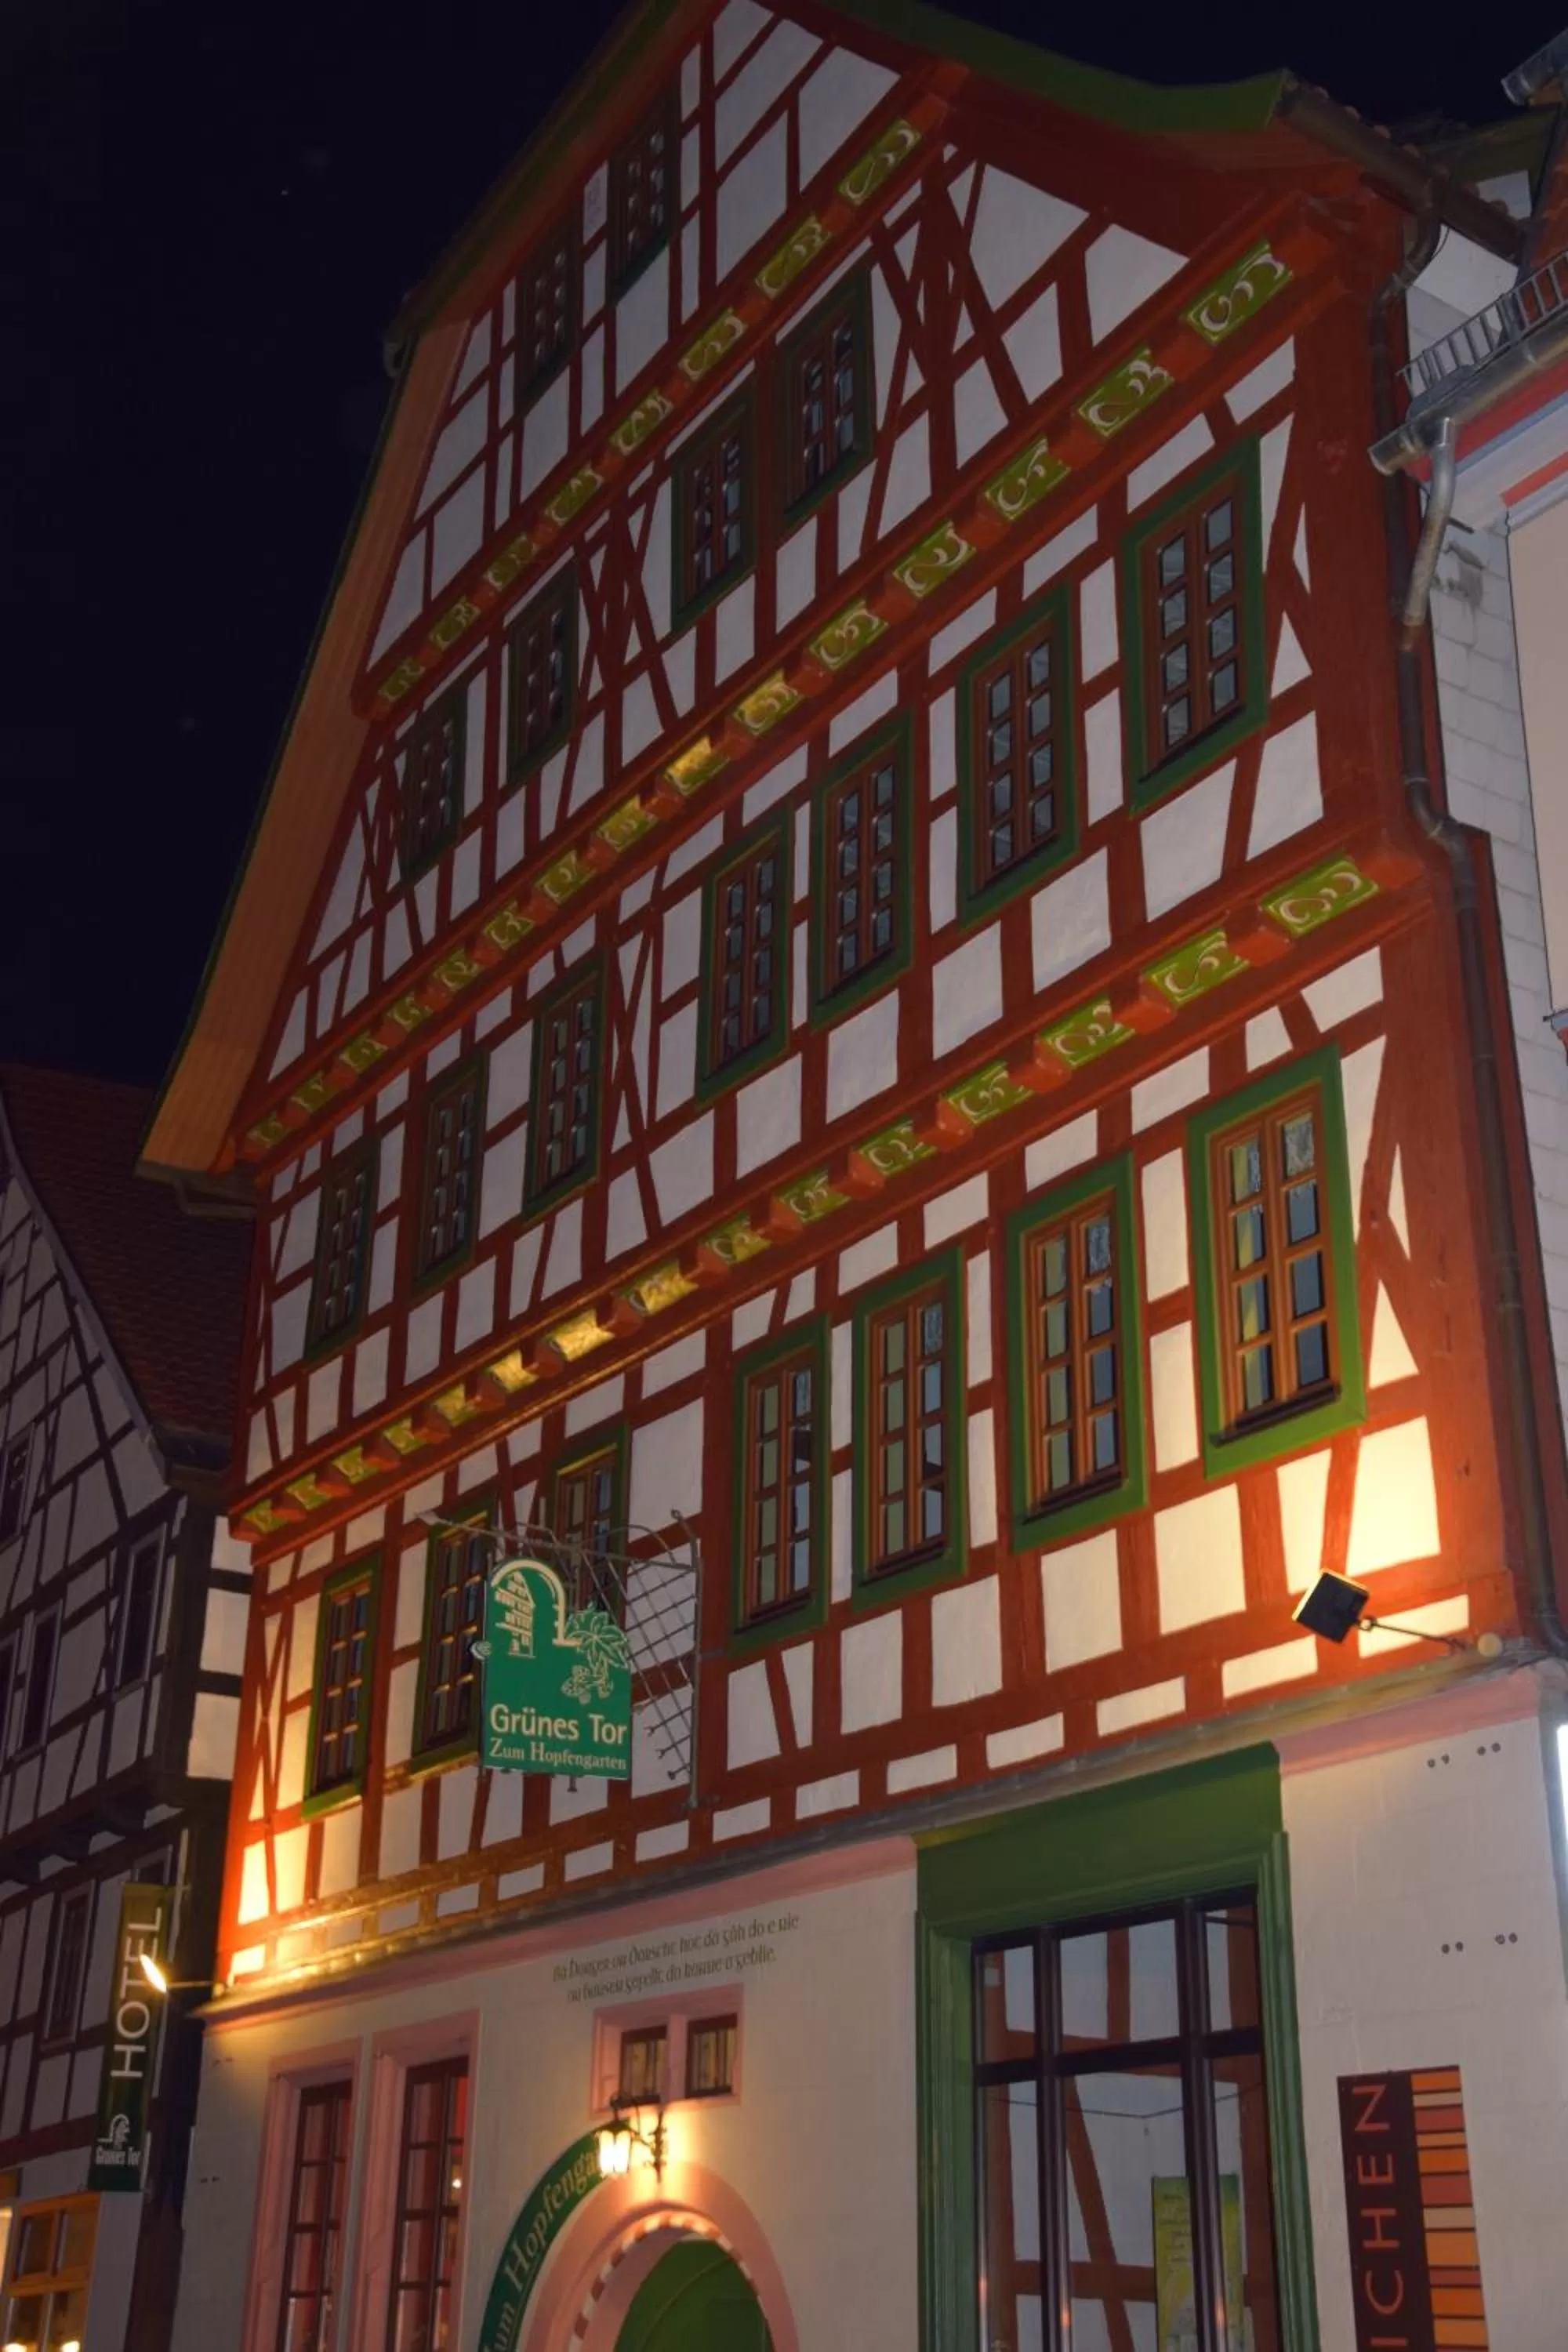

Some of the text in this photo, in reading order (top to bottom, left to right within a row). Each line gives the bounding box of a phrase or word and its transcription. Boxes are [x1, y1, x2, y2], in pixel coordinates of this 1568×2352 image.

[490, 1704, 627, 1744] Grünes Tor
[490, 1737, 626, 1769] Zum Hopfengarten
[111, 1907, 162, 2078] HOTEL
[484, 2151, 597, 2352] um Hopfenga
